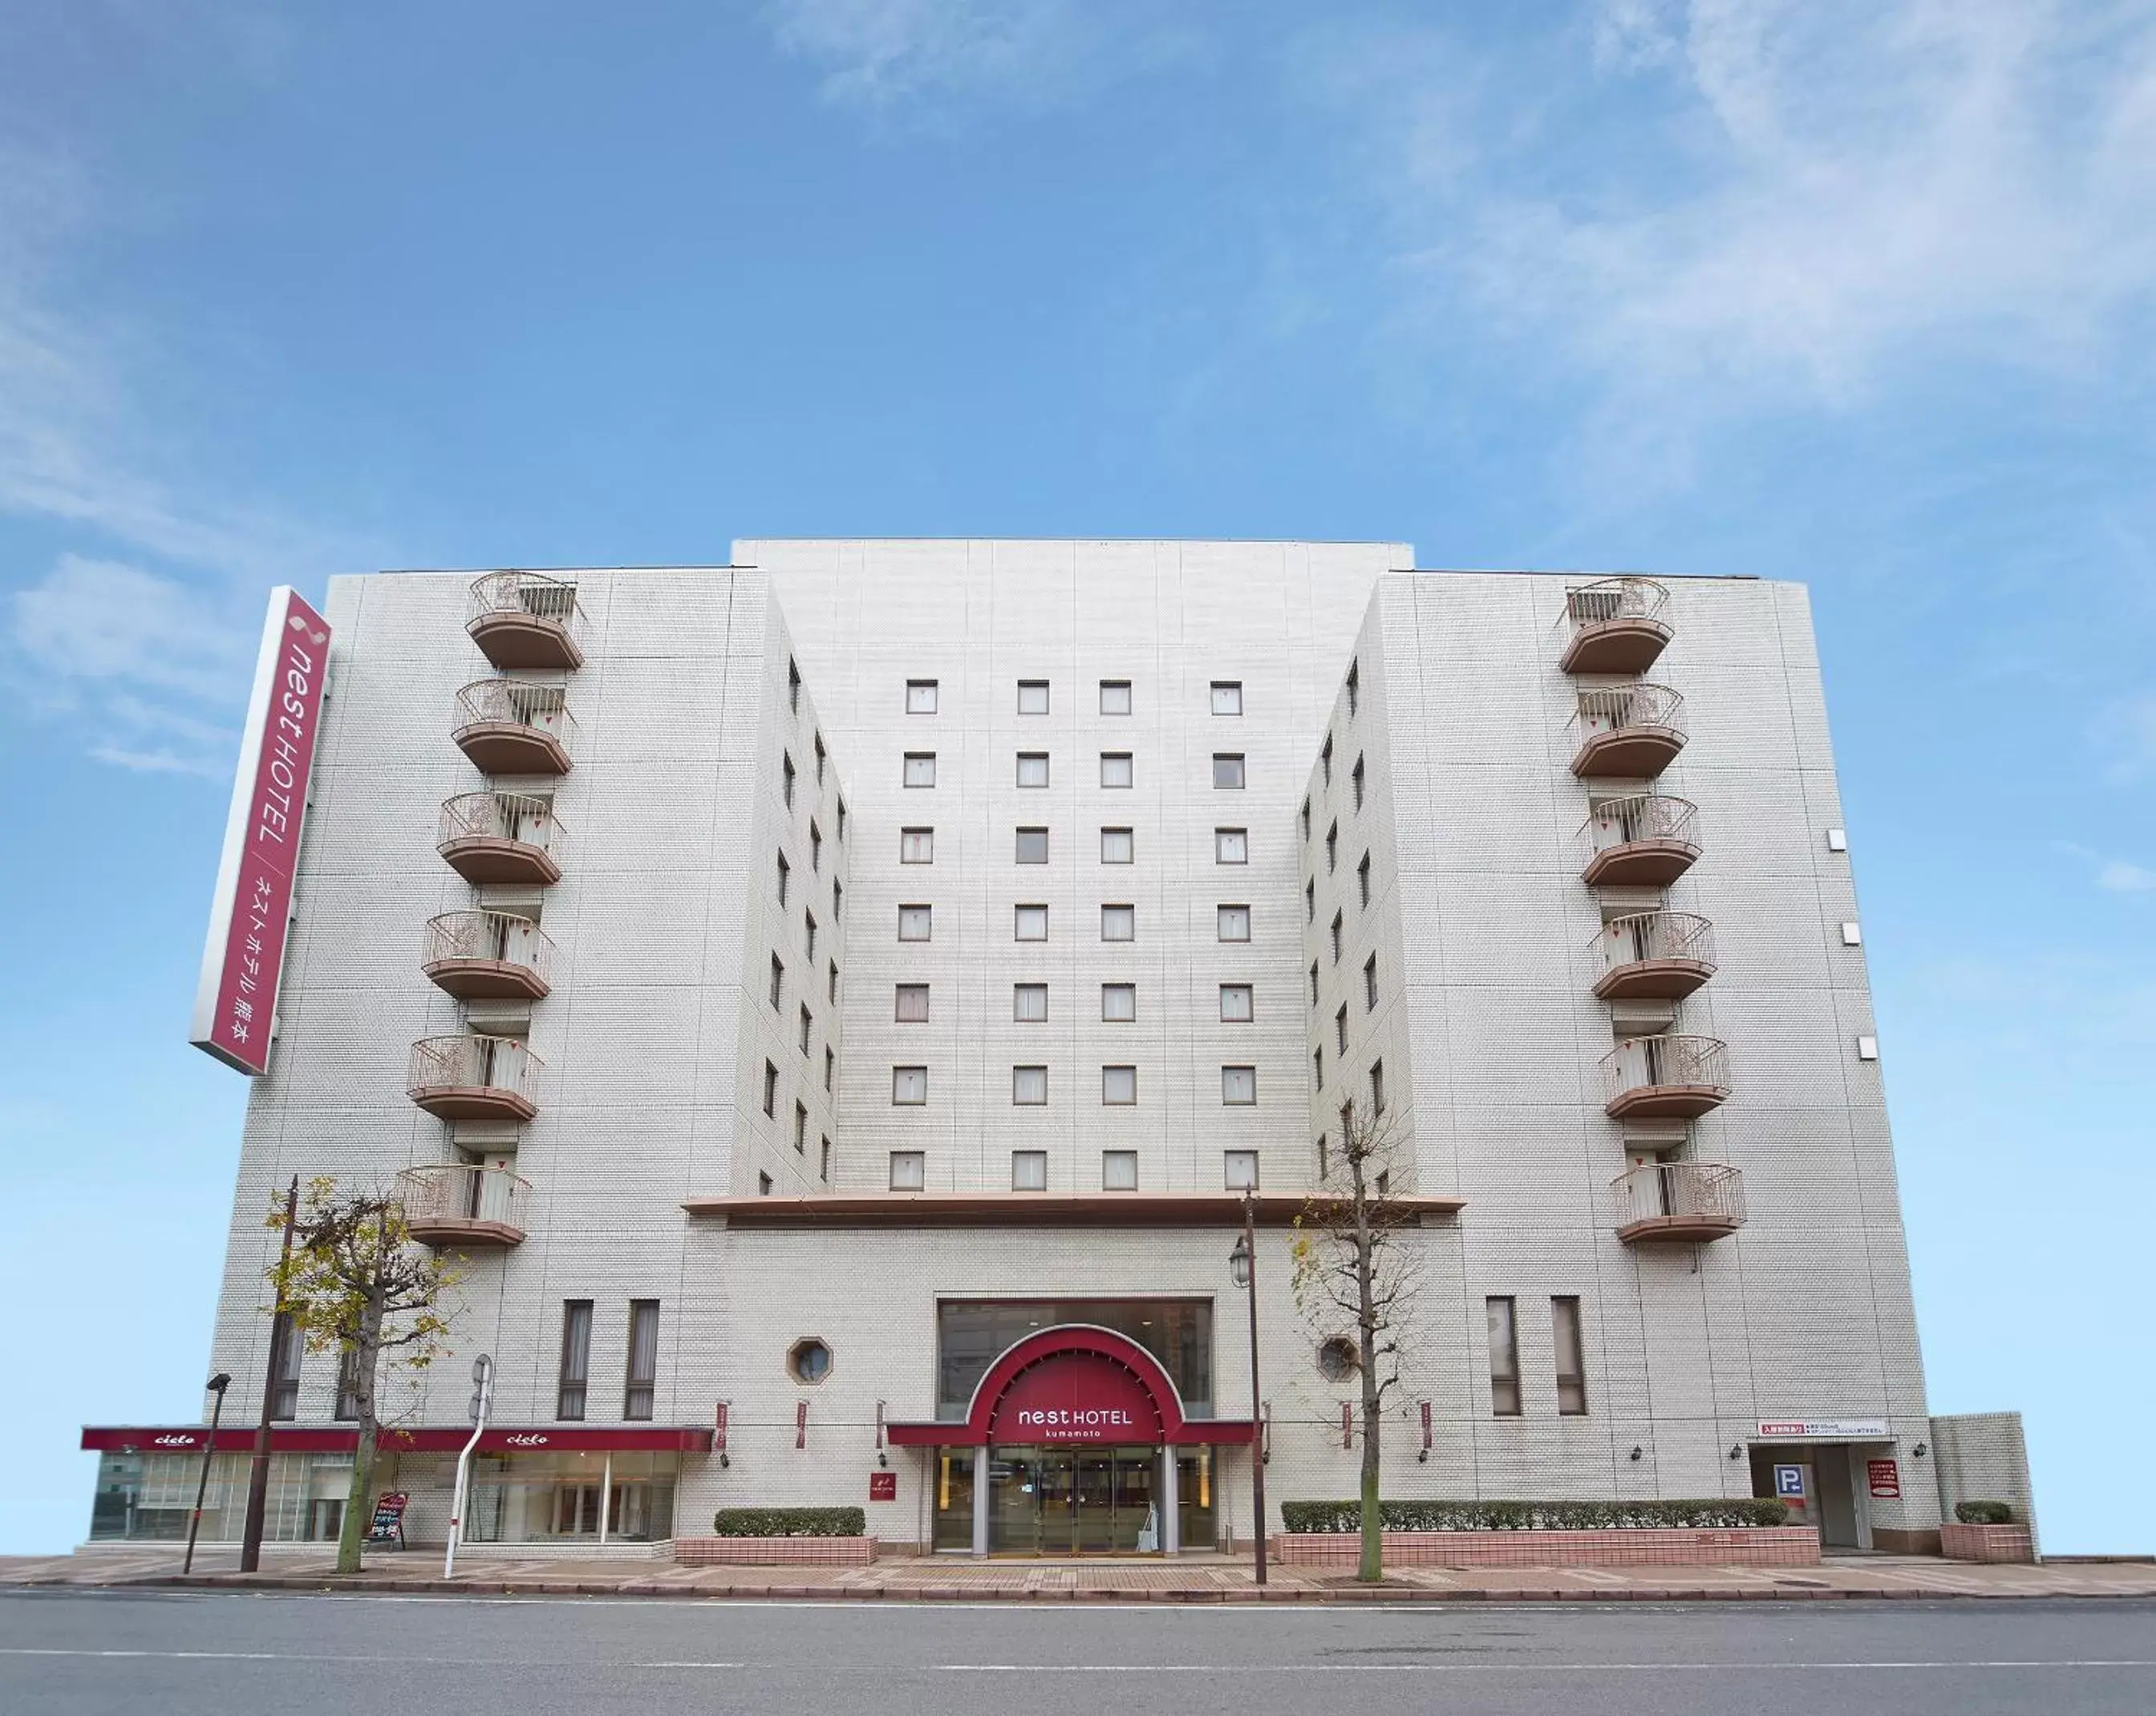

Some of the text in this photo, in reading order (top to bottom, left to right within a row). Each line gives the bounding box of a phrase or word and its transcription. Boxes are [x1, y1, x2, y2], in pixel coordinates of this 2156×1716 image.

[259, 643, 312, 843] nest HOTEL
[231, 876, 272, 1044] ネストホテル熊本
[1019, 1409, 1133, 1425] nest HOTEL
[1045, 1430, 1101, 1438] kumamoto
[1781, 1469, 1799, 1491] P
